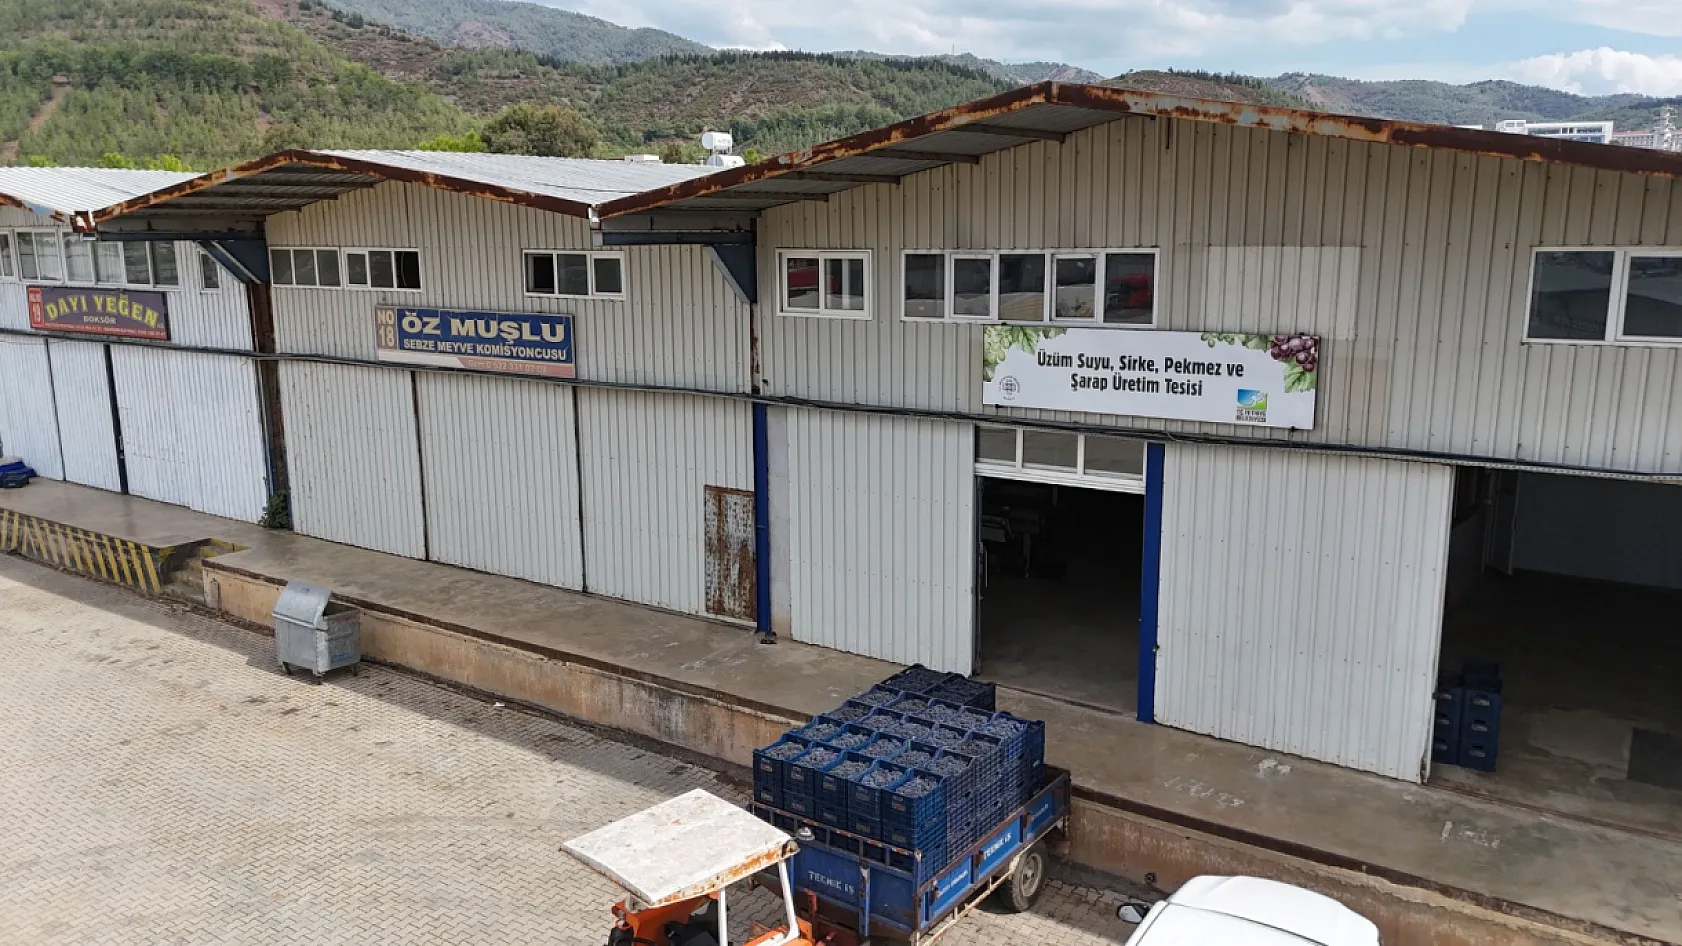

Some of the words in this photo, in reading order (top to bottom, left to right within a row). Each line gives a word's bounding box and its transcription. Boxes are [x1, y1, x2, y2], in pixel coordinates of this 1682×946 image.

[46, 295, 88, 320] DAYI
[93, 293, 159, 328] YEĞEN
[377, 309, 394, 325] NO
[379, 325, 395, 347] 18
[402, 311, 440, 335] ÖZ
[450, 317, 565, 345] MUŞLU
[404, 339, 435, 351] SEBZE
[438, 341, 474, 353] MEYVE
[477, 342, 566, 361] KOMİSYONCUSU
[1037, 348, 1073, 368] Üzüm
[1077, 353, 1114, 371] Suyu,
[1119, 355, 1159, 374] Sirke,
[1164, 357, 1222, 376] Pekmez
[1226, 363, 1244, 377] ve
[1070, 373, 1108, 392] Şarap
[1113, 372, 1159, 394] Üretim
[1164, 378, 1203, 396] Tesisi
